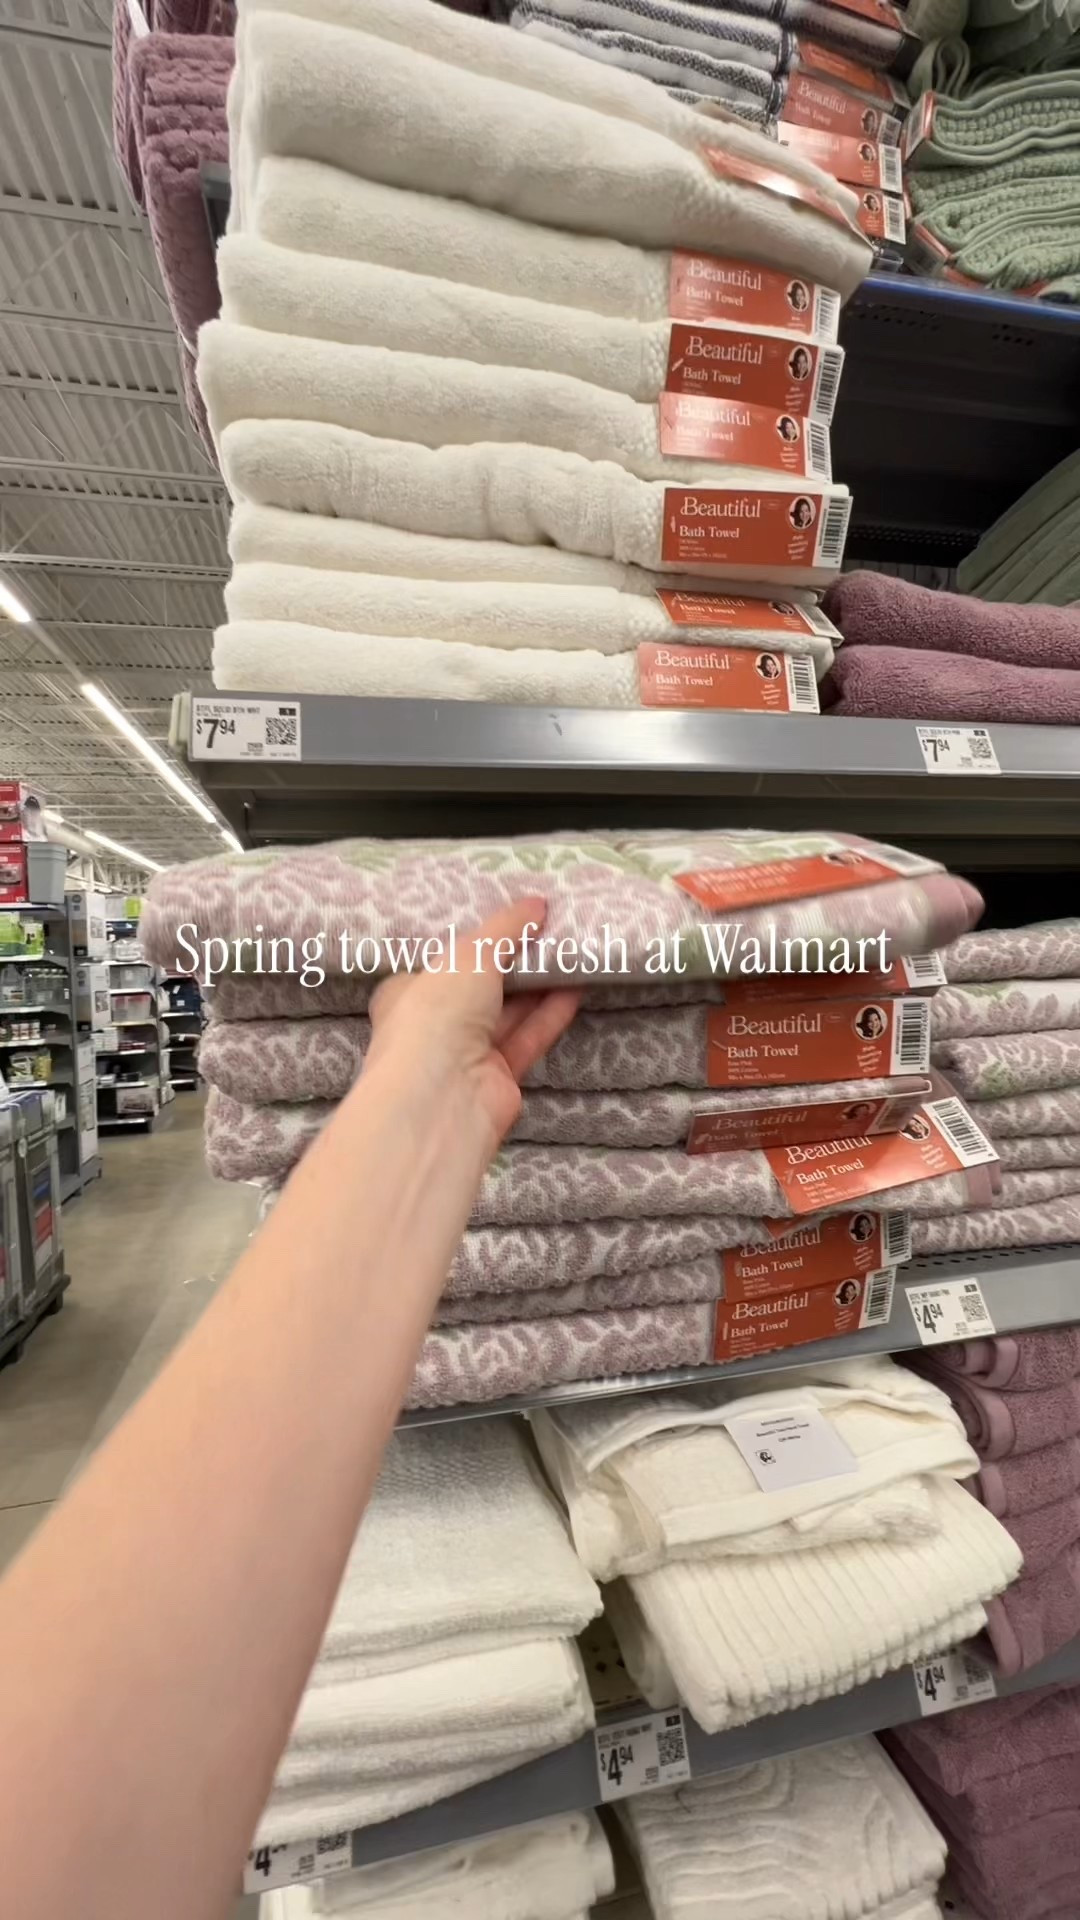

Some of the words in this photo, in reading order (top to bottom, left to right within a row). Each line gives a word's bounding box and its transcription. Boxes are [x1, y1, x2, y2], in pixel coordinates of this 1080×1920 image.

[799, 81, 848, 115] Beautiful
[687, 258, 762, 291] Beautiful
[686, 286, 712, 300] Bath
[715, 291, 743, 307] Towel
[686, 335, 763, 365] Beautiful
[683, 367, 708, 380] Bath
[712, 370, 741, 385] Towel
[680, 496, 761, 518] Beautiful
[679, 525, 705, 538] Bath
[709, 526, 740, 539] Towel
[655, 650, 730, 670] Beautiful
[656, 674, 681, 686] Bath
[684, 675, 713, 687] Towel
[727, 1012, 821, 1036] Beautiful
[727, 1046, 758, 1058] Bath
[761, 1044, 799, 1057] Towel
[796, 1169, 827, 1185] Bath
[830, 1158, 864, 1176] Towel
[742, 1263, 769, 1278] Bath
[770, 1256, 804, 1272] Towel
[732, 1292, 809, 1320] Beautiful
[730, 1326, 756, 1338] Bath
[760, 1319, 788, 1332] Towel
